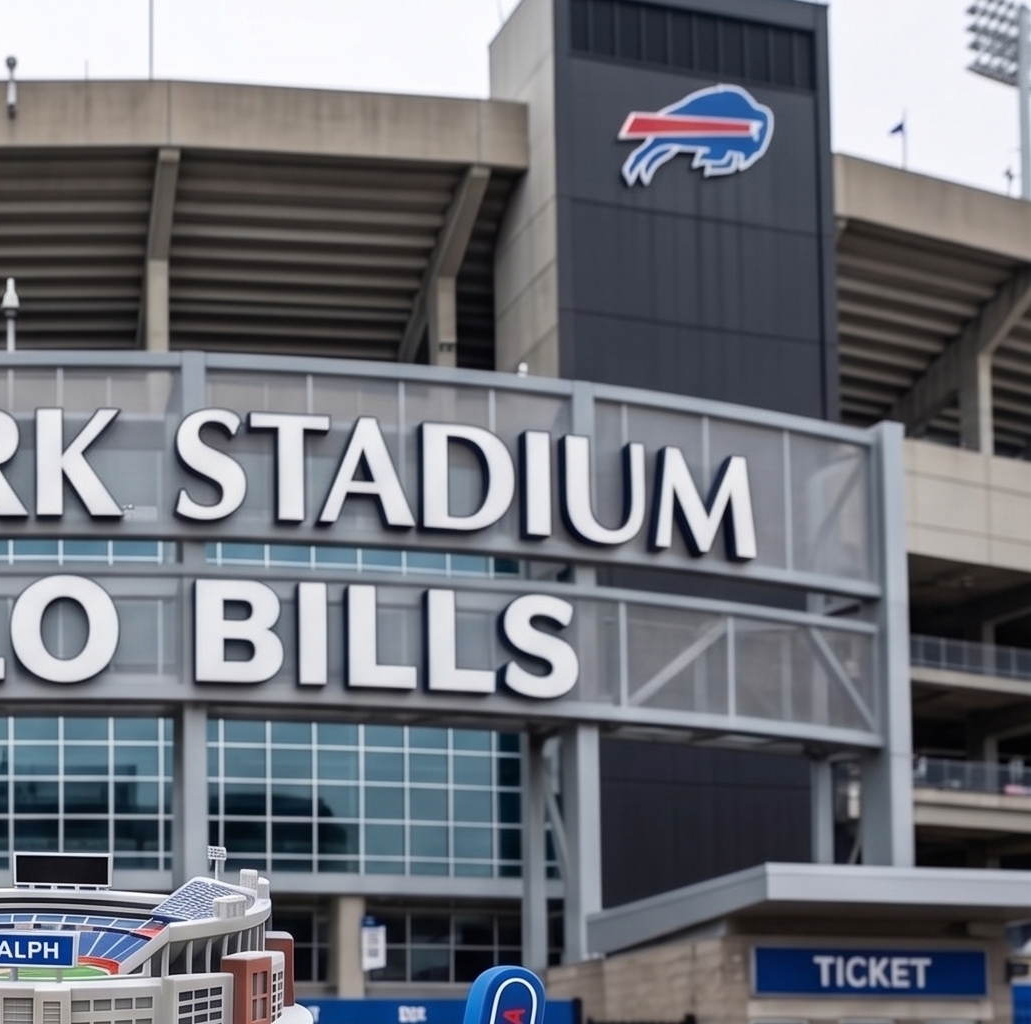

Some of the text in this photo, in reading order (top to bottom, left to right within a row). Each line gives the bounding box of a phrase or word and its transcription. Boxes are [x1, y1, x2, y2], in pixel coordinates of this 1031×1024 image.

[173, 408, 758, 560] STADIUM
[193, 578, 580, 699] BILLS
[813, 955, 932, 989] TICKET
